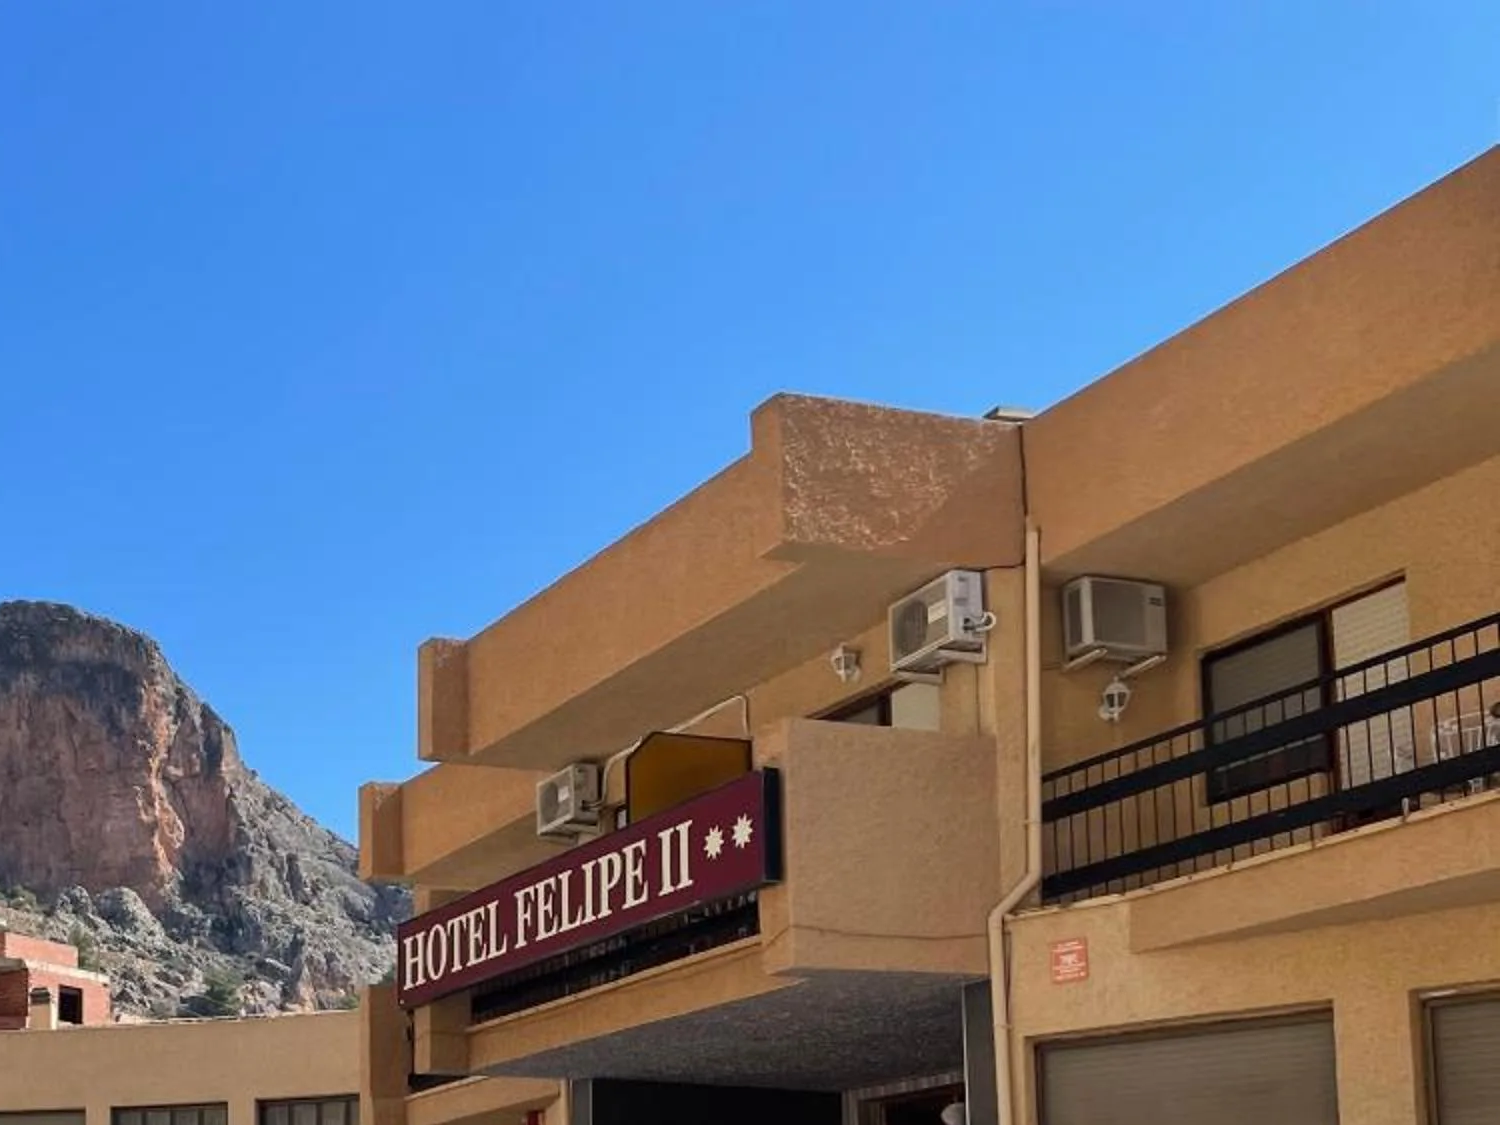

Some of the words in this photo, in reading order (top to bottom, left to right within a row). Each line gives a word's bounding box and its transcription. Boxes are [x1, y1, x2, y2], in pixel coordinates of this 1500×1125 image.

[403, 900, 507, 991] HOTEL
[514, 838, 648, 949] FELIPE
[658, 819, 695, 897] II
